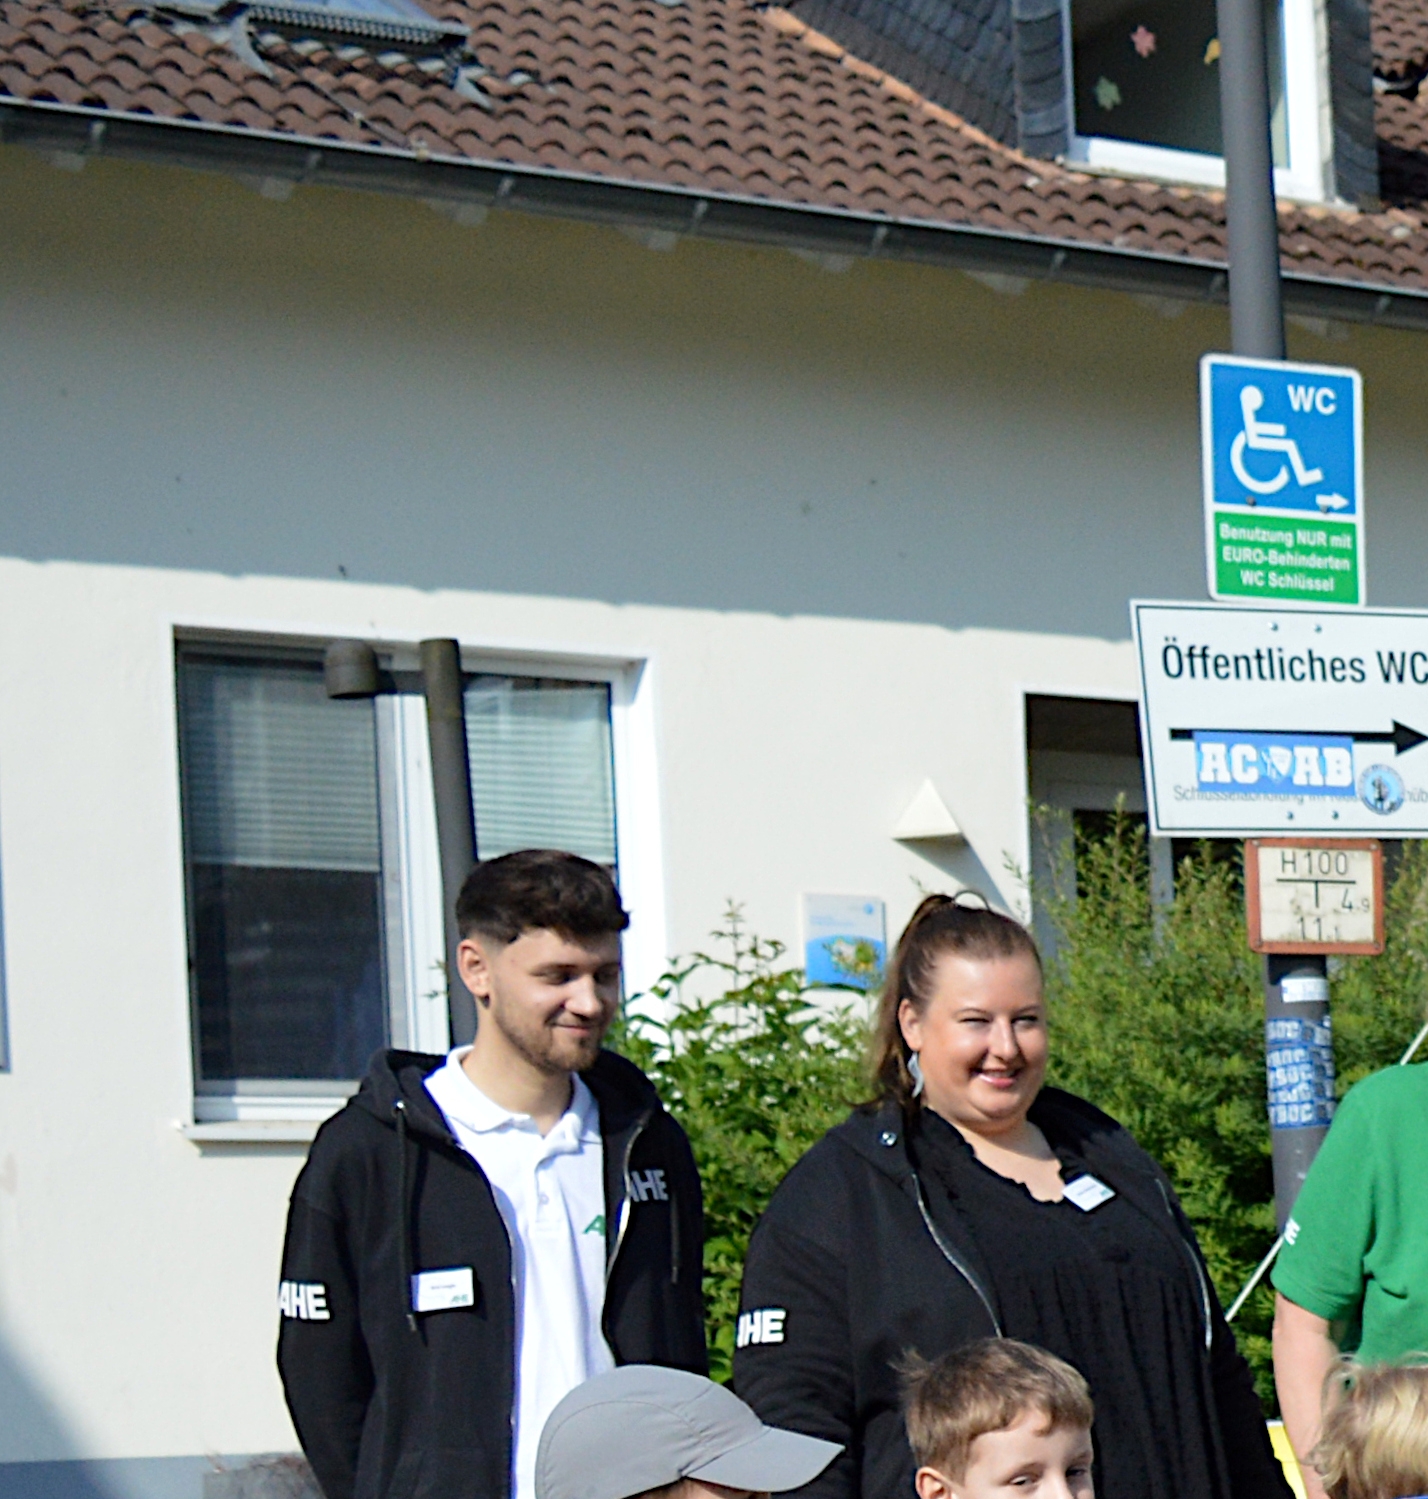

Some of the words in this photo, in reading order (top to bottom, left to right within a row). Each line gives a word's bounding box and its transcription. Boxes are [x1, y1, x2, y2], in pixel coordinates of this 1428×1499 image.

[1287, 384, 1337, 416] WC
[1219, 522, 1294, 547] Benutzung
[1296, 529, 1328, 547] NUR
[1329, 532, 1353, 549] mit
[1222, 546, 1352, 571] EURO-Behinderten
[1240, 569, 1265, 587] WC
[1268, 572, 1335, 591] Schlüssel
[1162, 636, 1366, 684] Öffentliches
[1281, 850, 1348, 875] H100
[279, 1280, 330, 1320] AHE
